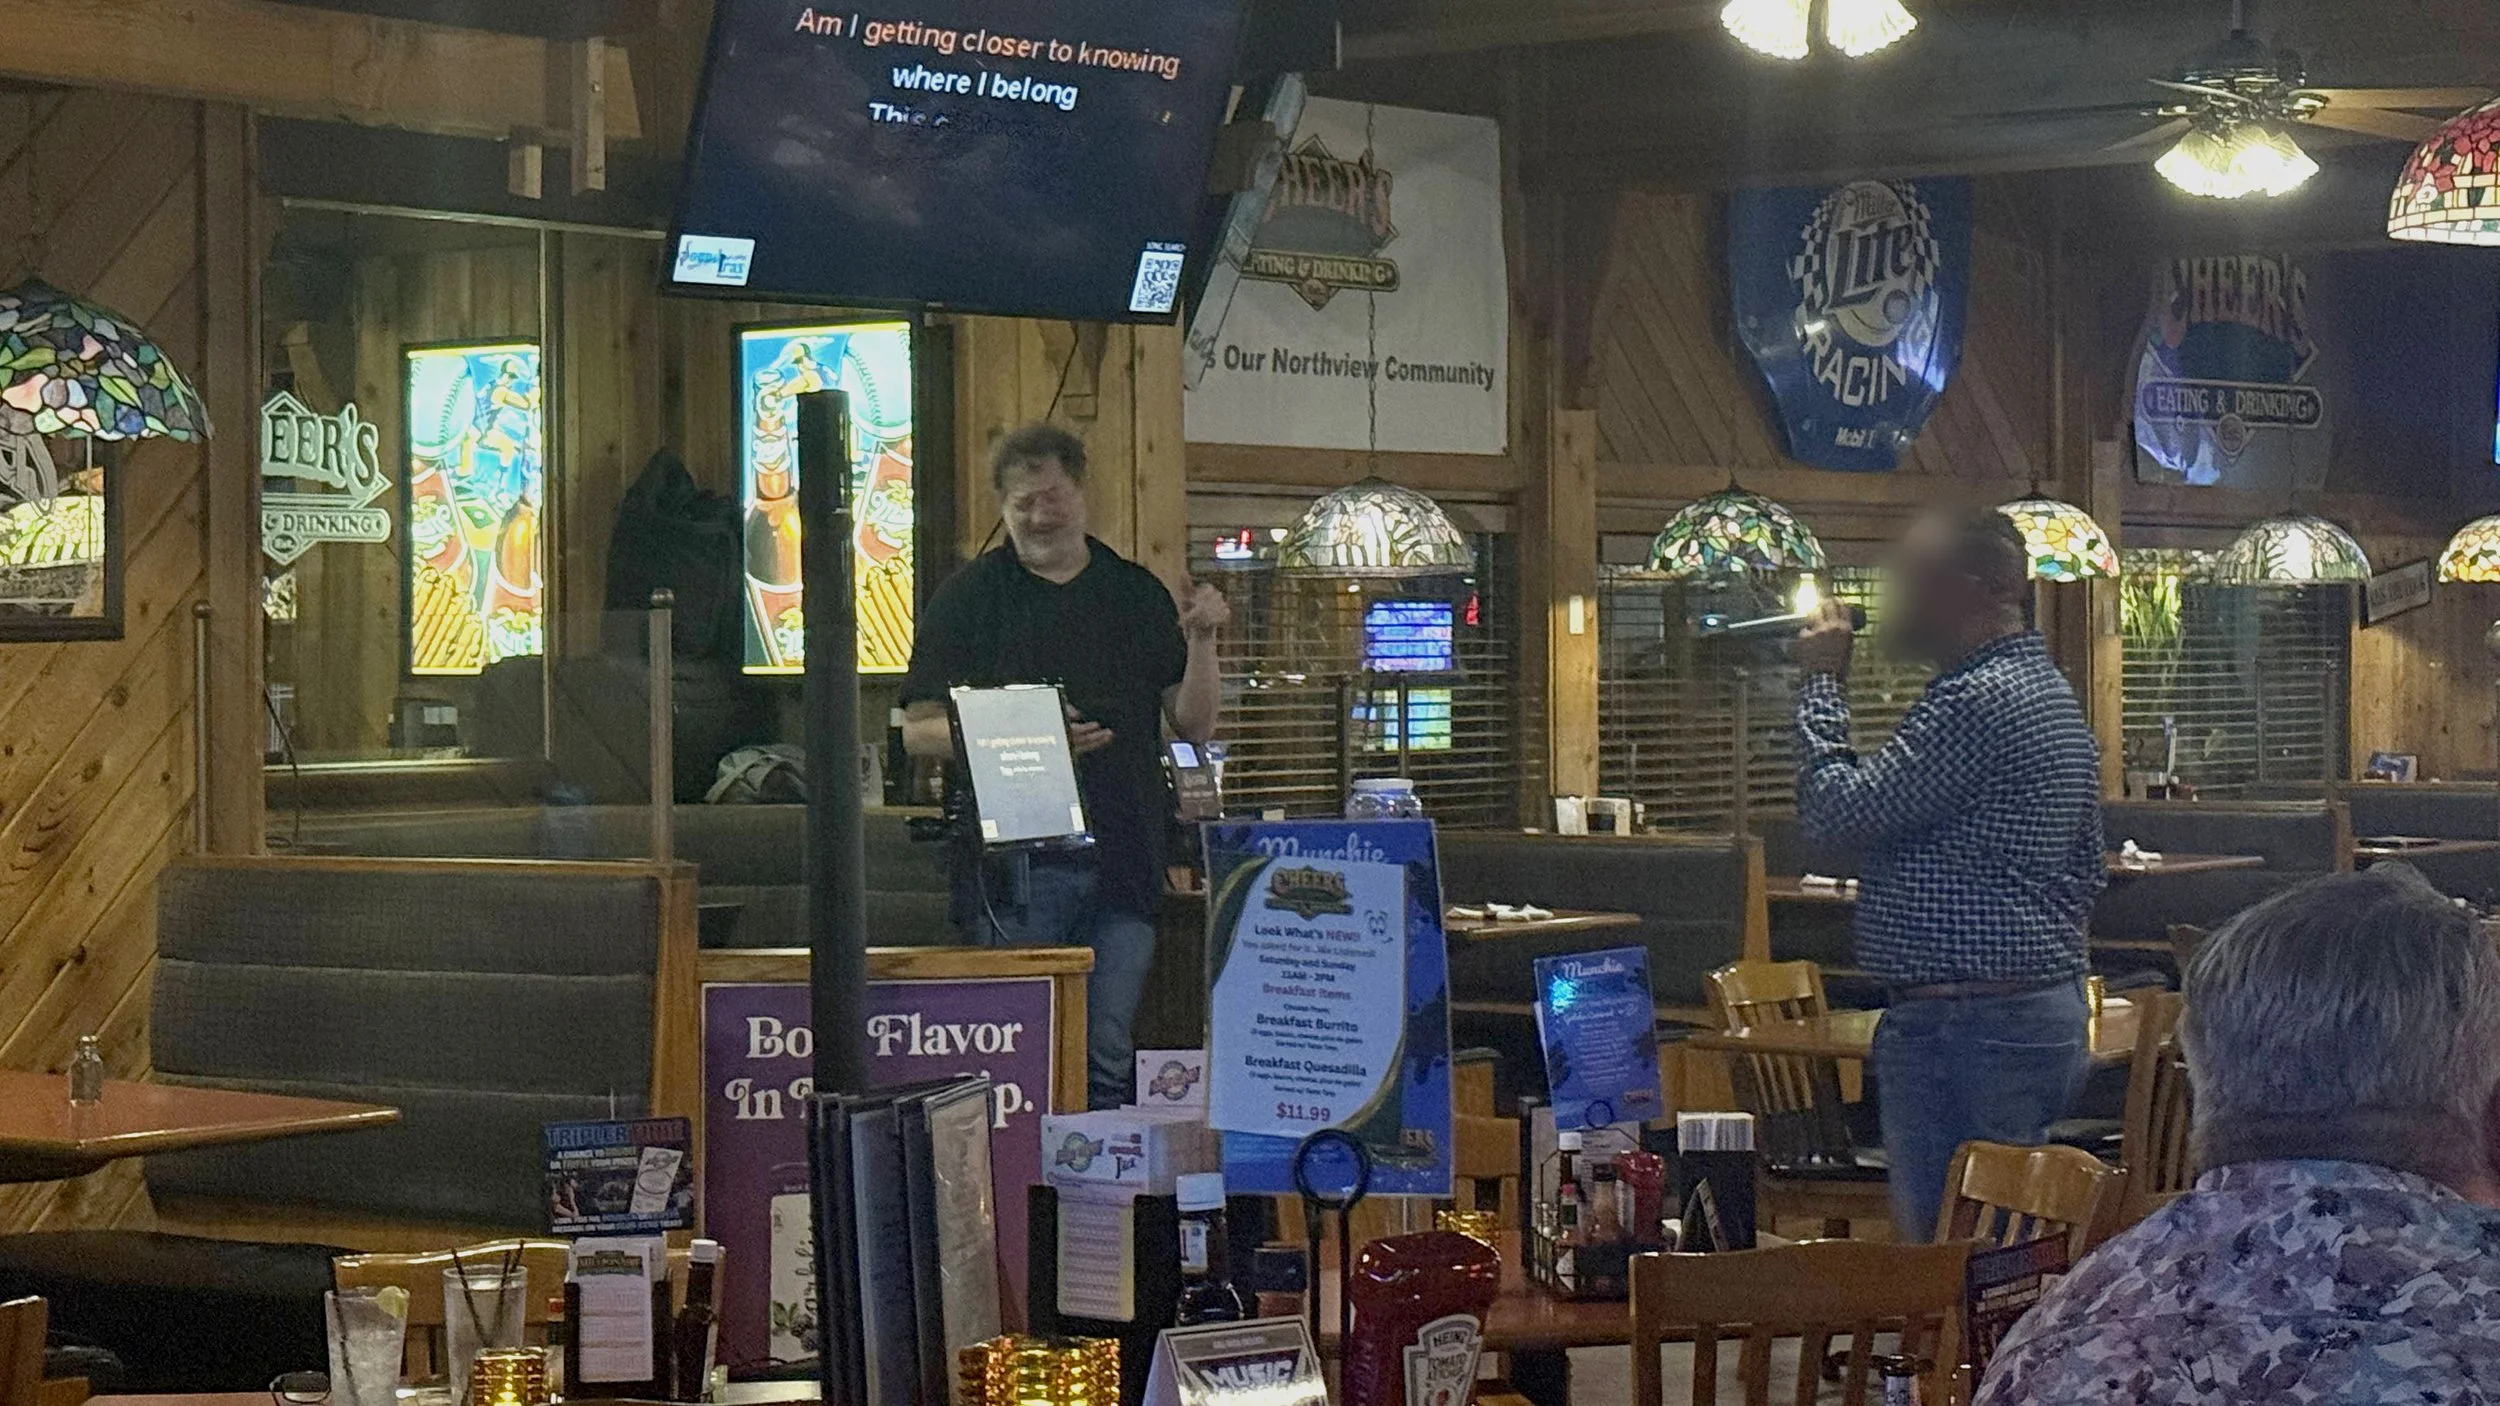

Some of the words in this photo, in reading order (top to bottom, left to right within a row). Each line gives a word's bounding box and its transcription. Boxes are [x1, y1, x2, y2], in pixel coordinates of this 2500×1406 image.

[796, 7, 844, 37] Am
[849, 14, 859, 40] I
[863, 19, 957, 54] getting
[962, 29, 1046, 62] closer
[1049, 39, 1073, 64] to
[1078, 41, 1182, 79] knowing
[893, 65, 972, 96] where
[977, 72, 988, 97] I
[991, 73, 1079, 111] belong
[1312, 258, 1386, 282] DRINKIG
[1224, 345, 1266, 372] Our
[1272, 347, 1379, 380] Northview
[1385, 356, 1495, 393] Community
[2156, 388, 2209, 413] EATING
[2216, 390, 2227, 414] &
[2235, 391, 2309, 419] DRINKING
[267, 404, 380, 494] EER'S
[282, 511, 372, 535] DRINKING
[1258, 832, 1385, 862] Munchie
[1255, 924, 1282, 938] Look
[1284, 926, 1324, 941] What's
[1262, 981, 1316, 998] Breakfast
[744, 1015, 814, 1059] Bo
[866, 1012, 1024, 1058] Flavor
[1257, 1013, 1313, 1029] Breakfast
[1316, 1017, 1359, 1033] Burrito
[1244, 1055, 1301, 1071] Breakfast
[1304, 1060, 1367, 1077] Quesadilla
[724, 1077, 785, 1121] In
[1276, 1101, 1332, 1122] $11.99
[1432, 1330, 1468, 1348] HEINZ
[1202, 1359, 1293, 1392] MUSIC
